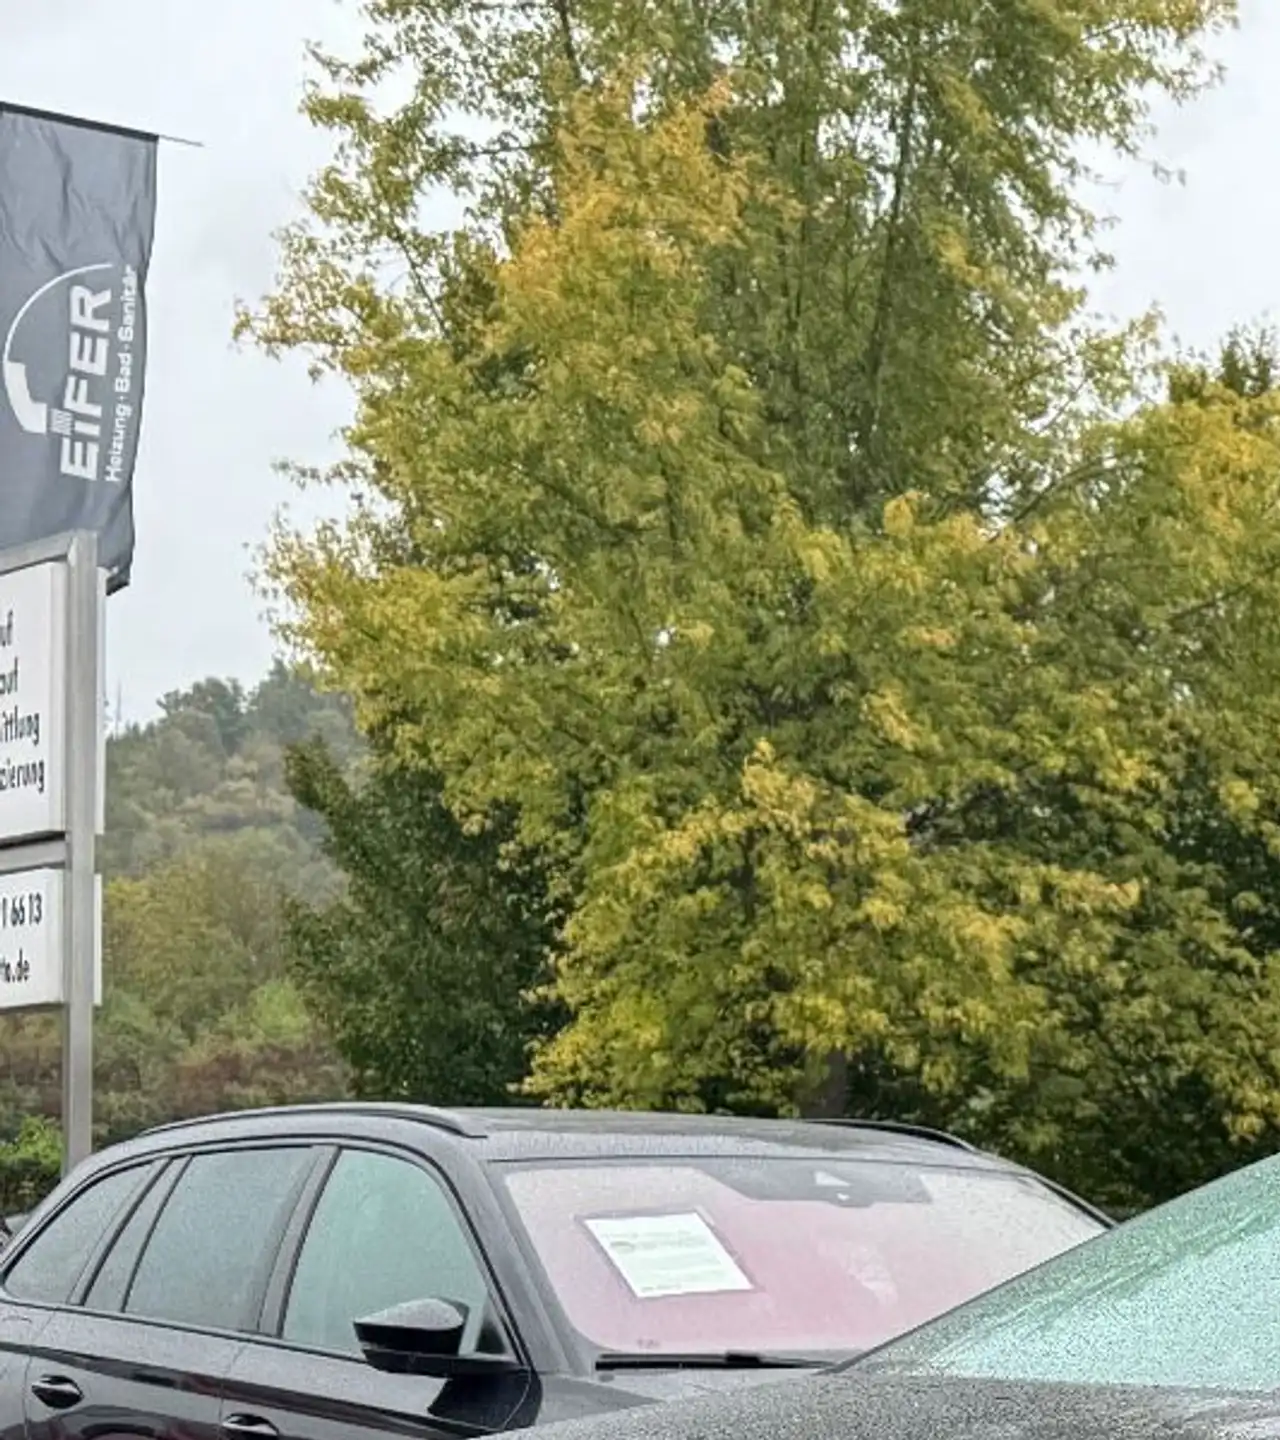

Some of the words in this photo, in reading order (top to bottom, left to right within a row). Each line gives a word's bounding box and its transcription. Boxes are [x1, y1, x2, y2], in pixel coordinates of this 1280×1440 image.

[114, 352, 133, 393] Bad
[105, 402, 132, 482] Heizung
[28, 891, 43, 925] 13
